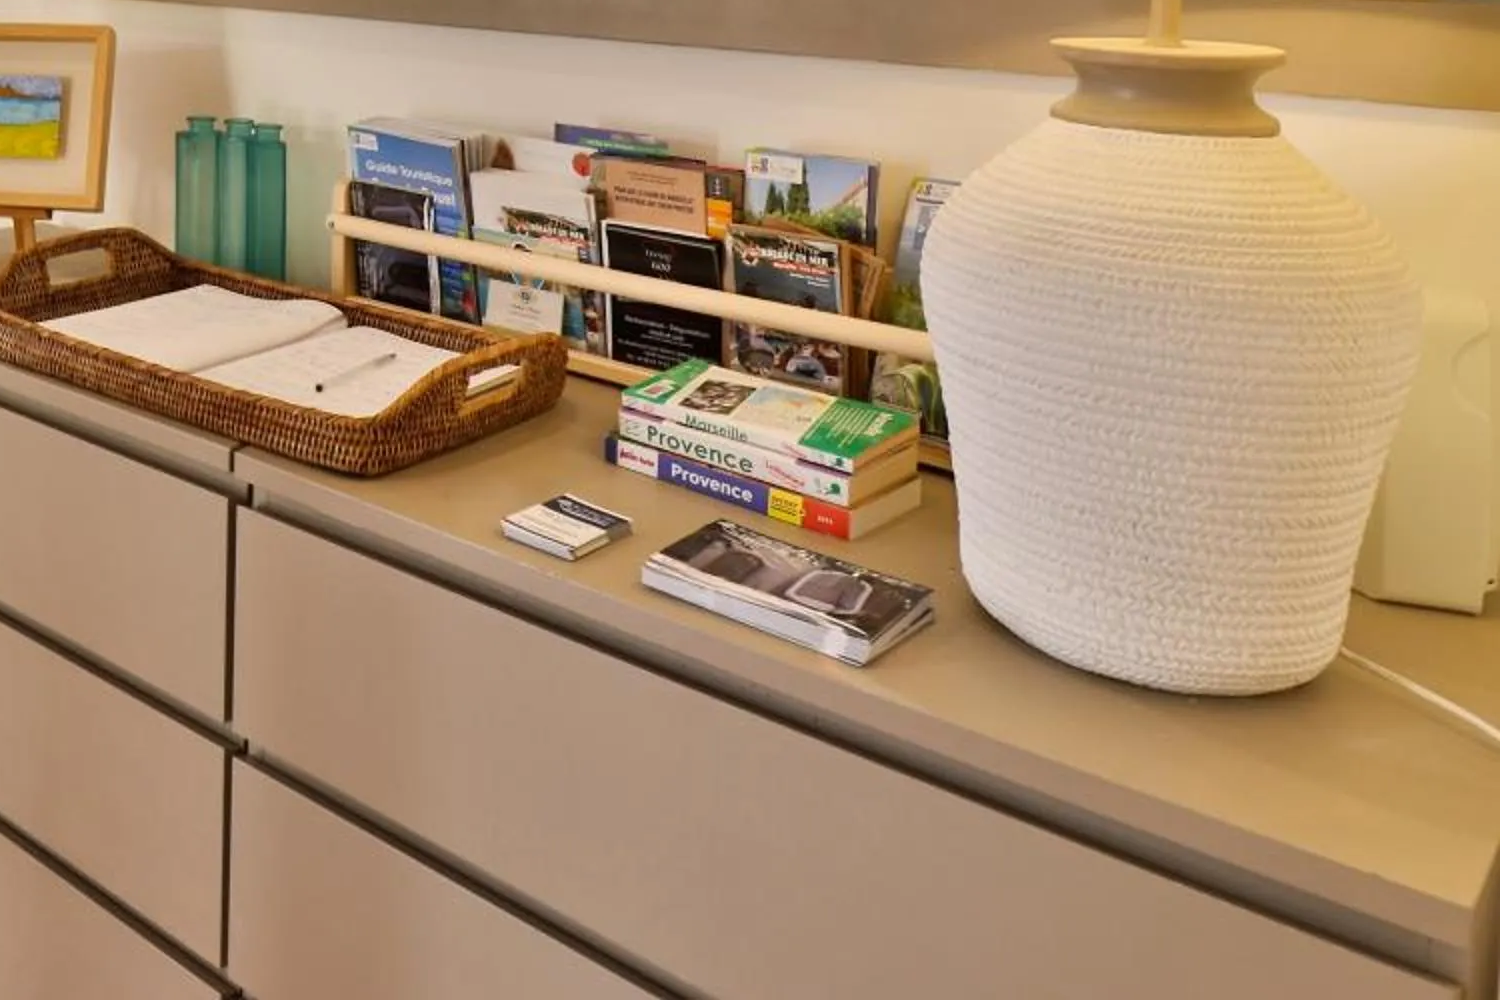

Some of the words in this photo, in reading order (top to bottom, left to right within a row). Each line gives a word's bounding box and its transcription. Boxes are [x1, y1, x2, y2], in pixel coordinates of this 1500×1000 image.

[685, 412, 749, 443] Marseille
[646, 424, 755, 474] Provence
[670, 462, 754, 503] Provence
